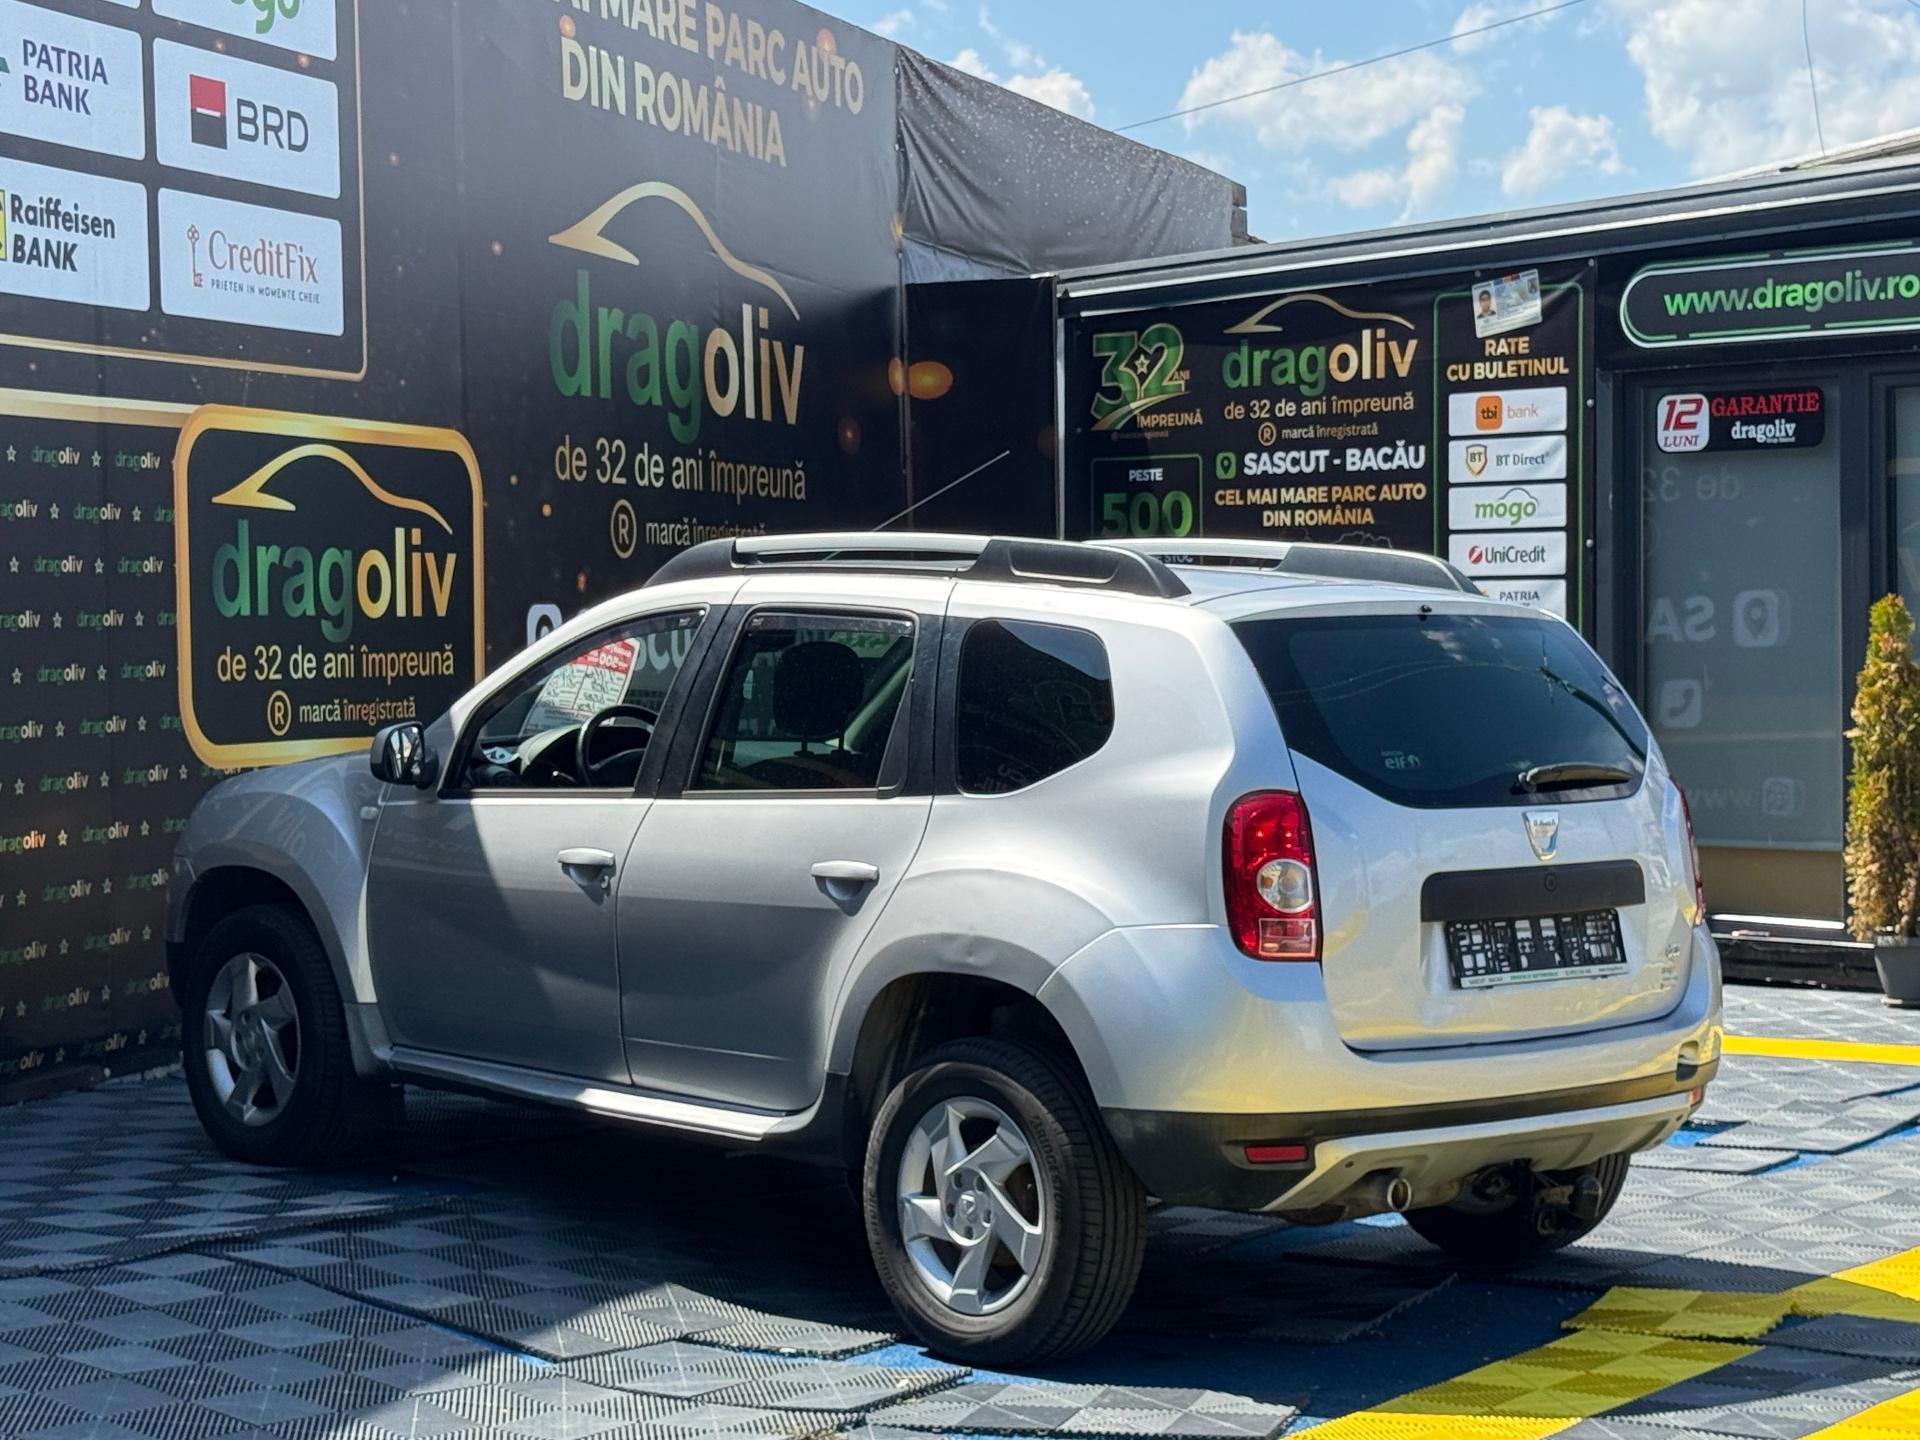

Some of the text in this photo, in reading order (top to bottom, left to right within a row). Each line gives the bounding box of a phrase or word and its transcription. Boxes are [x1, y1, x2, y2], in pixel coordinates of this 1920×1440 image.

[23, 40, 108, 85] PATRIA
[705, 3, 786, 86] PARC
[792, 40, 864, 114] AUTO
[24, 75, 91, 115] BANK
[561, 37, 786, 167] DIN ROMÂNIA
[237, 98, 309, 152] BRD
[11, 194, 116, 239] Raiffeisen
[13, 234, 78, 272] BANK
[208, 230, 319, 284] CreditFix
[211, 278, 244, 292] PRIETEN
[1664, 269, 1920, 316] www.dragoliv.ro
[549, 269, 804, 444] dragoliv
[1485, 336, 1530, 357] RATE
[1091, 323, 1185, 421] 32
[1222, 328, 1418, 396] dragoliv
[1446, 357, 1570, 382] CU BULETINUL
[1224, 391, 1415, 420] de 32 de ani împreună
[1480, 403, 1539, 420] tbi bank
[1663, 398, 1704, 431] 12
[1711, 392, 1820, 417] GARANTIE
[1282, 427, 1315, 440] marcă
[1663, 435, 1699, 448] LUNI
[1731, 419, 1796, 443] dragoliv
[32, 446, 161, 472] dragoliv dragoliv
[555, 435, 807, 506] de 32 de ani împreună
[1243, 449, 1330, 475] SASCUT
[1345, 440, 1427, 472] BACĂU
[1469, 451, 1483, 463] BT
[1496, 454, 1510, 467] BT
[1128, 467, 1164, 482] PESTE
[1215, 482, 1427, 506] CEL MAI MARE PARC AUTO
[0, 499, 122, 524] agoliv dragoliv
[1101, 490, 1193, 538] 500
[1263, 504, 1375, 527] DIN ROMÂNIA
[1475, 501, 1536, 526] mogo
[646, 517, 691, 546] marcă
[34, 555, 164, 577] dragoliv dragoliv
[1485, 546, 1546, 564] UniCredit
[211, 519, 457, 643] dragoliv
[1499, 590, 1541, 602] PATRIA
[0, 609, 124, 632] ragoliv dragoliv
[37, 660, 166, 686] dragoliv dragoliv
[217, 645, 454, 685] de 32 de ani împreună
[299, 700, 341, 725] marcă
[344, 696, 416, 727] înregistrată
[0, 715, 127, 743] ragoliv dragoliv
[40, 764, 169, 794] dragoliv dragoliv
[0, 821, 130, 854] ragoliv dragoliv
